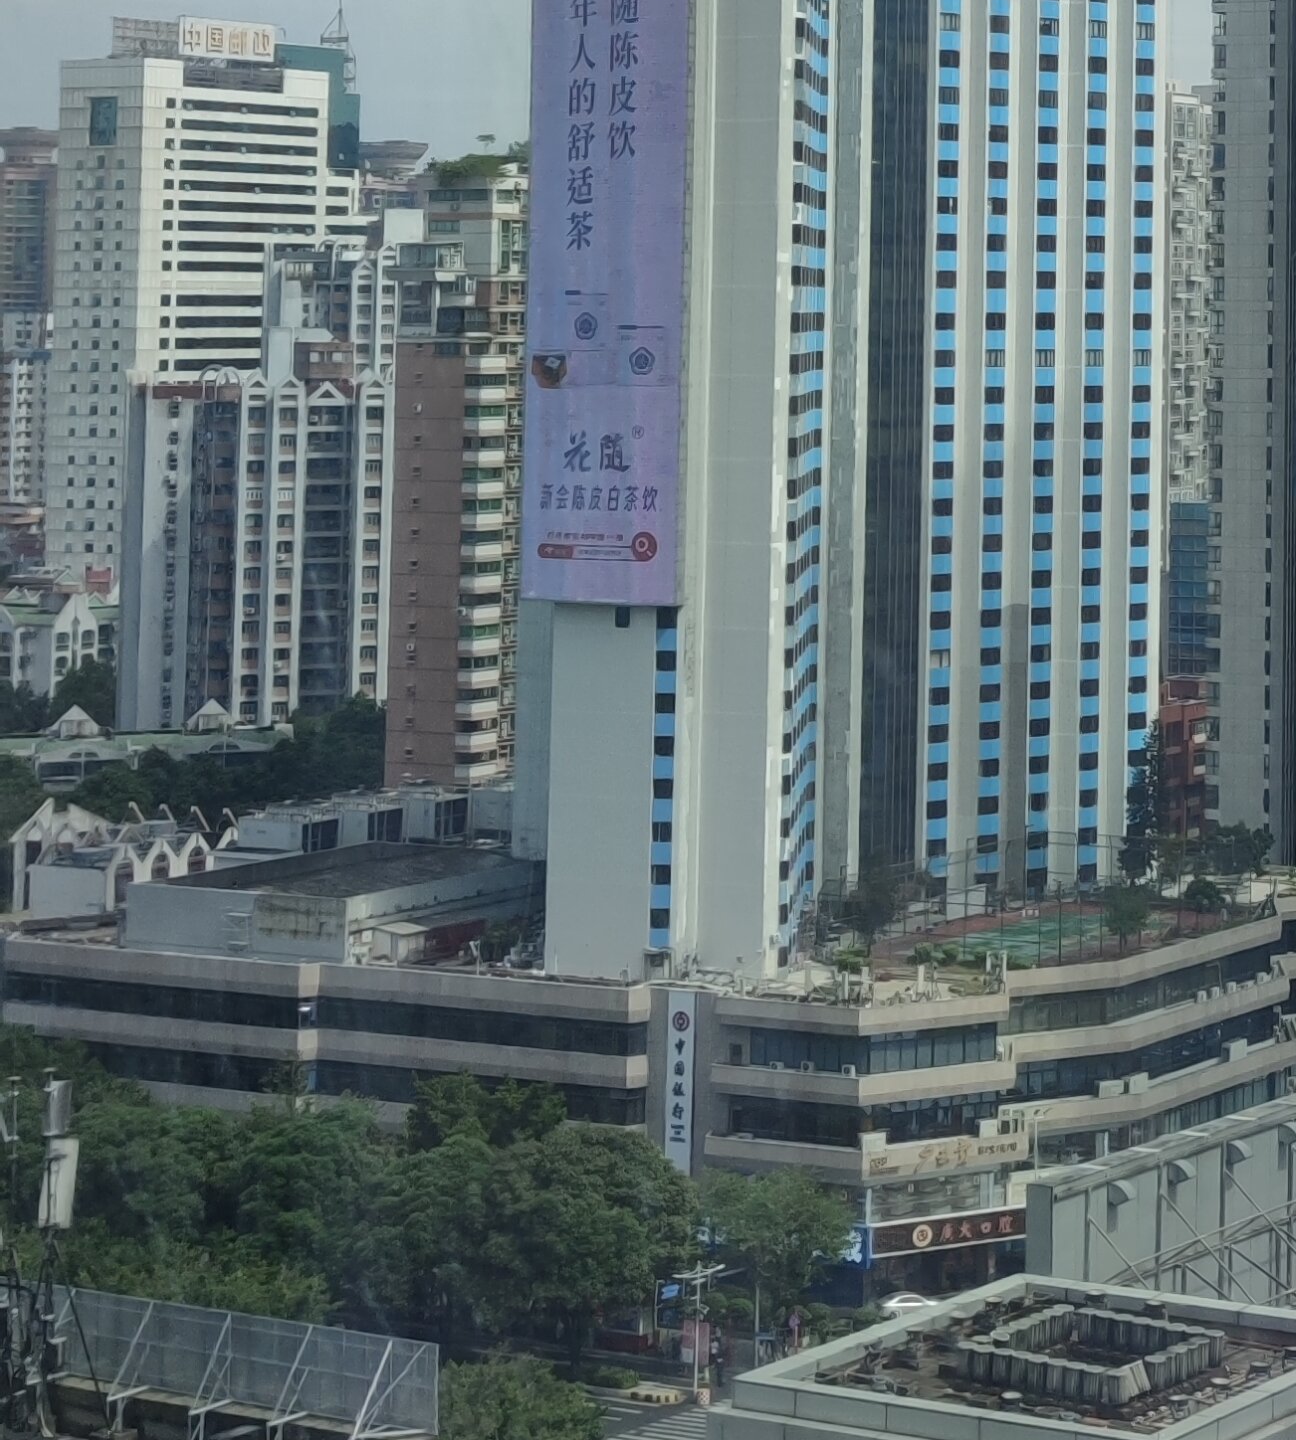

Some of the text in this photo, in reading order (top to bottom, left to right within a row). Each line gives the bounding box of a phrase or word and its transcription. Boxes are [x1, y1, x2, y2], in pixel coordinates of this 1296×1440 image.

[563, 429, 631, 473] 花随
[540, 484, 658, 512] 新会陈皮白茶饮
